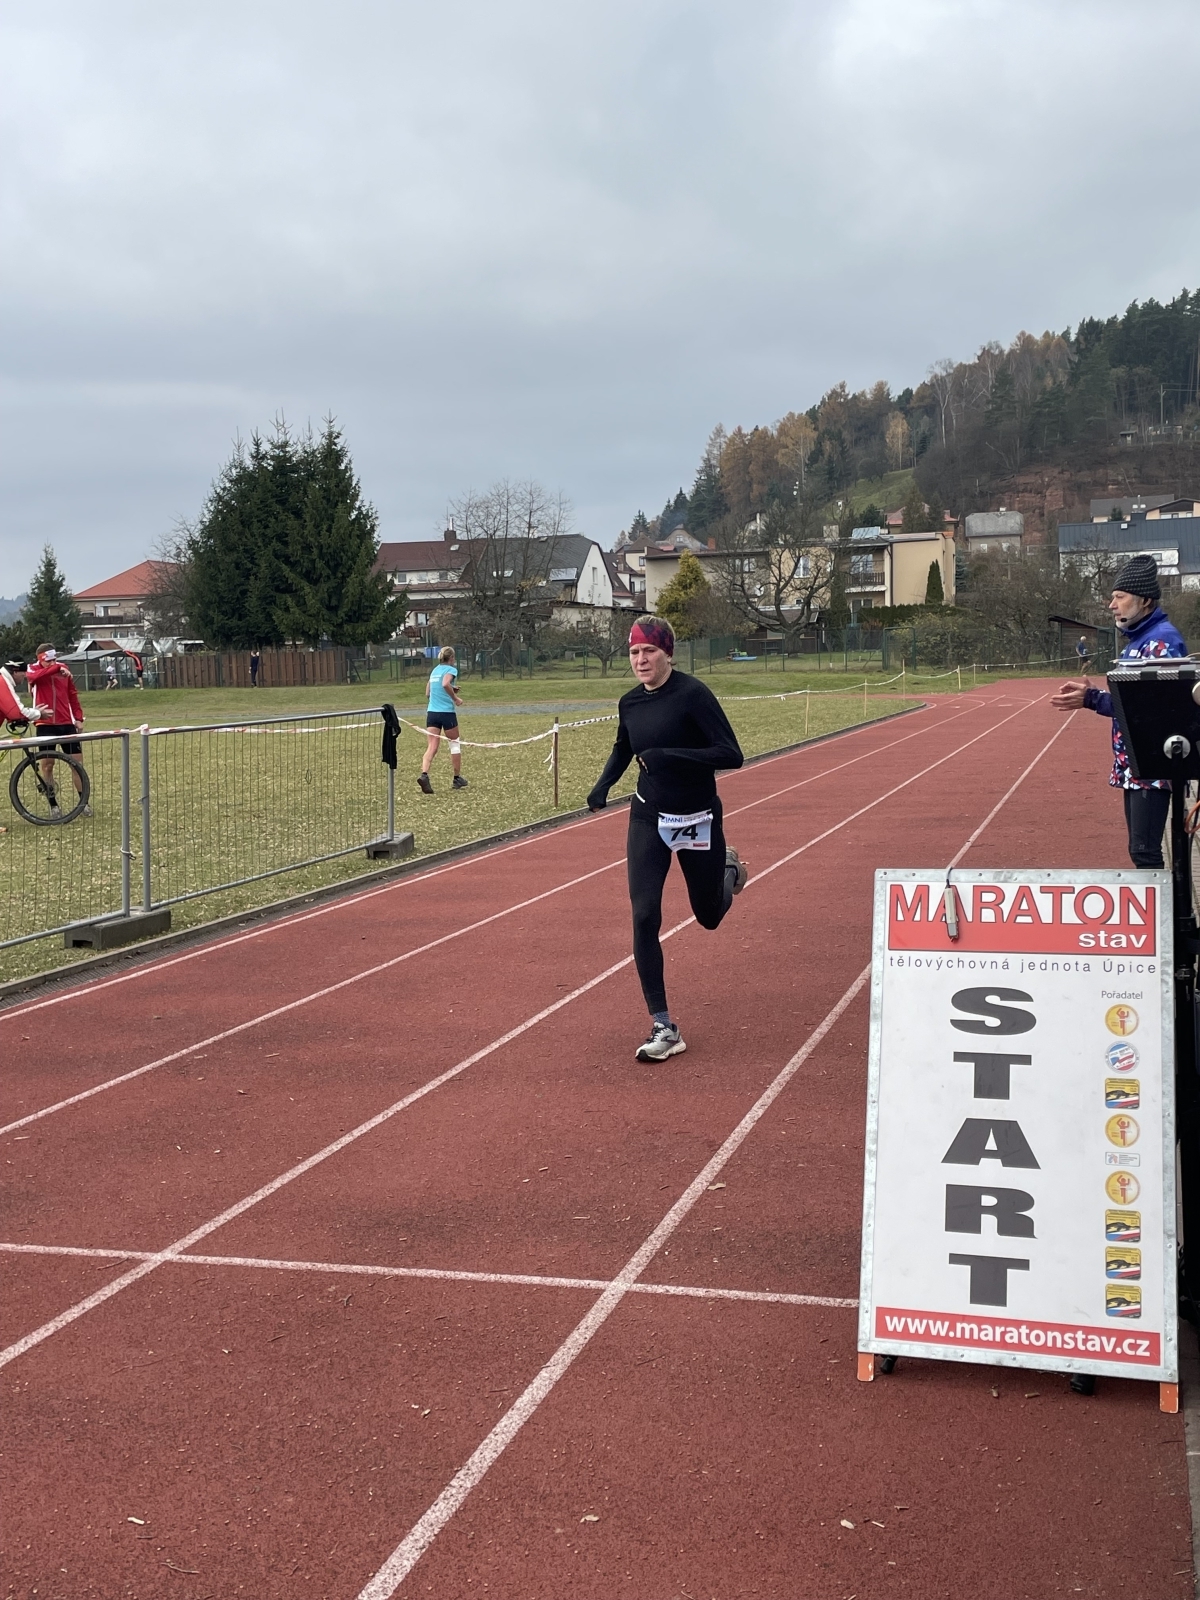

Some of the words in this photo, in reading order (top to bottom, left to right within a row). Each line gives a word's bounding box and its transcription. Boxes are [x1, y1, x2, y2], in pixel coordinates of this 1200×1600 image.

[671, 825, 698, 841] 74
[889, 884, 1156, 926] MARATON
[1078, 930, 1148, 948] stav
[889, 956, 1010, 971] tělovýchovná
[1020, 958, 1092, 973] jednota
[1102, 959, 1157, 975] Úpice
[1100, 990, 1144, 1001] Pořadatel
[941, 987, 1041, 1307] START
[884, 1315, 1151, 1357] www.maratonstav.cz
